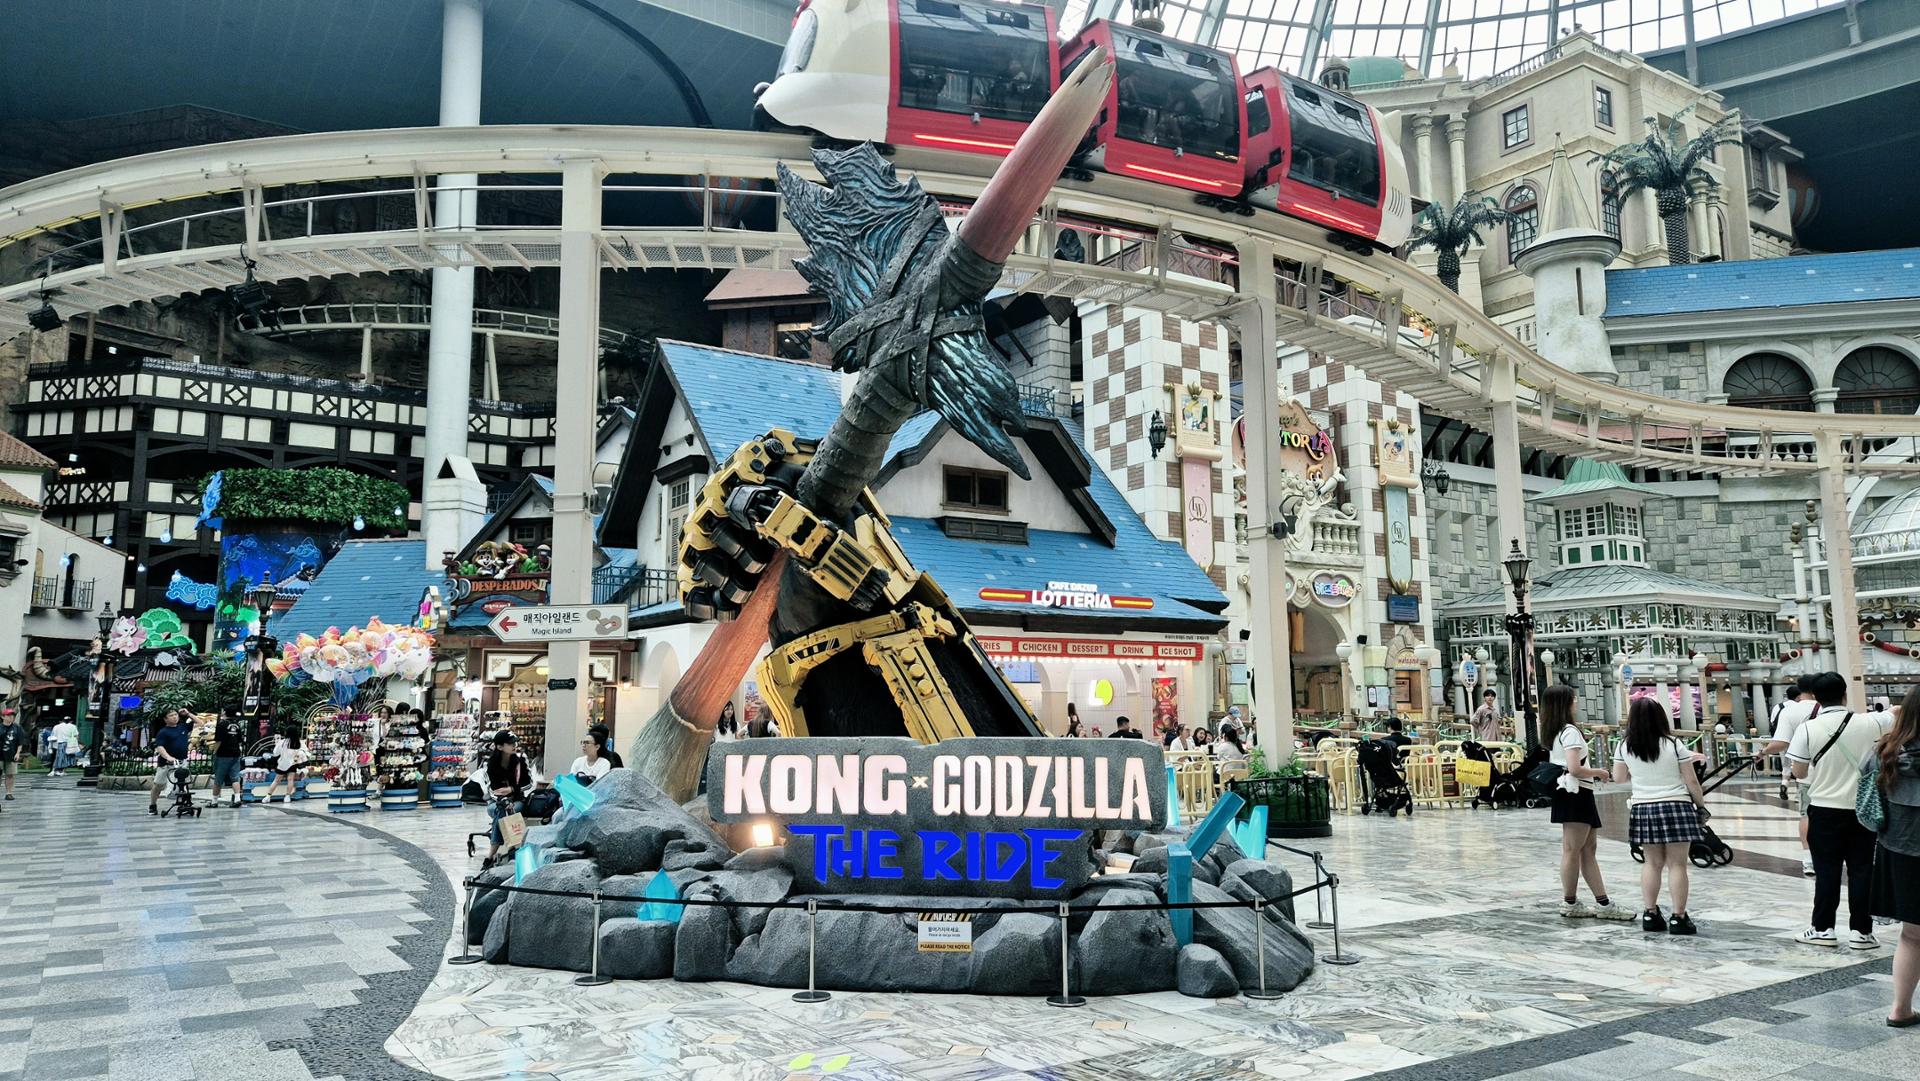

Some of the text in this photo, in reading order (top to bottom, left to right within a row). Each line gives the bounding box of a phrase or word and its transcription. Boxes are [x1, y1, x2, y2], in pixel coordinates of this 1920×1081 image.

[1279, 430, 1332, 462] TORIA
[444, 578, 471, 603] 3D
[471, 579, 538, 592] DESPERADOS
[1031, 590, 1112, 609] LOTTERIA
[523, 610, 581, 624] 매직아일랜드
[532, 628, 551, 636] Magic
[1022, 643, 1058, 652] CHICKEN
[1072, 644, 1103, 653] DESSERT
[1122, 646, 1144, 655] DRINK
[1161, 647, 1192, 656] ICE SHOT
[723, 754, 907, 815] KONG
[932, 755, 1153, 821] GODZILLA
[786, 824, 1085, 890] THE RIDE
